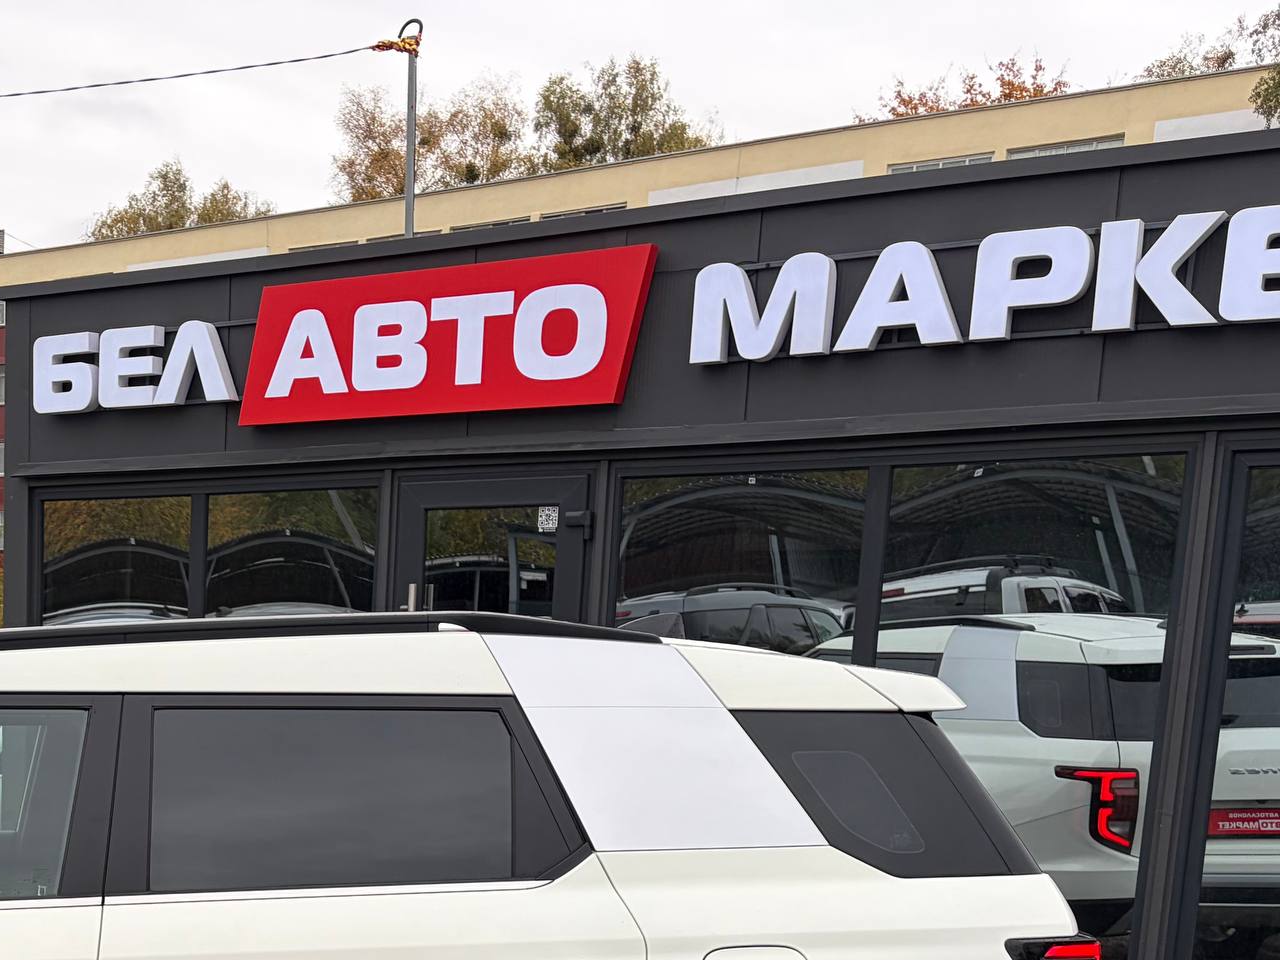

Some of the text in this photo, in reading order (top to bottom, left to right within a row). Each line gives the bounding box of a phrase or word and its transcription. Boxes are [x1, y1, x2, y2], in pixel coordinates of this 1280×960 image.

[33, 205, 1280, 414] БЕЛ АВТО МАРКЕ
